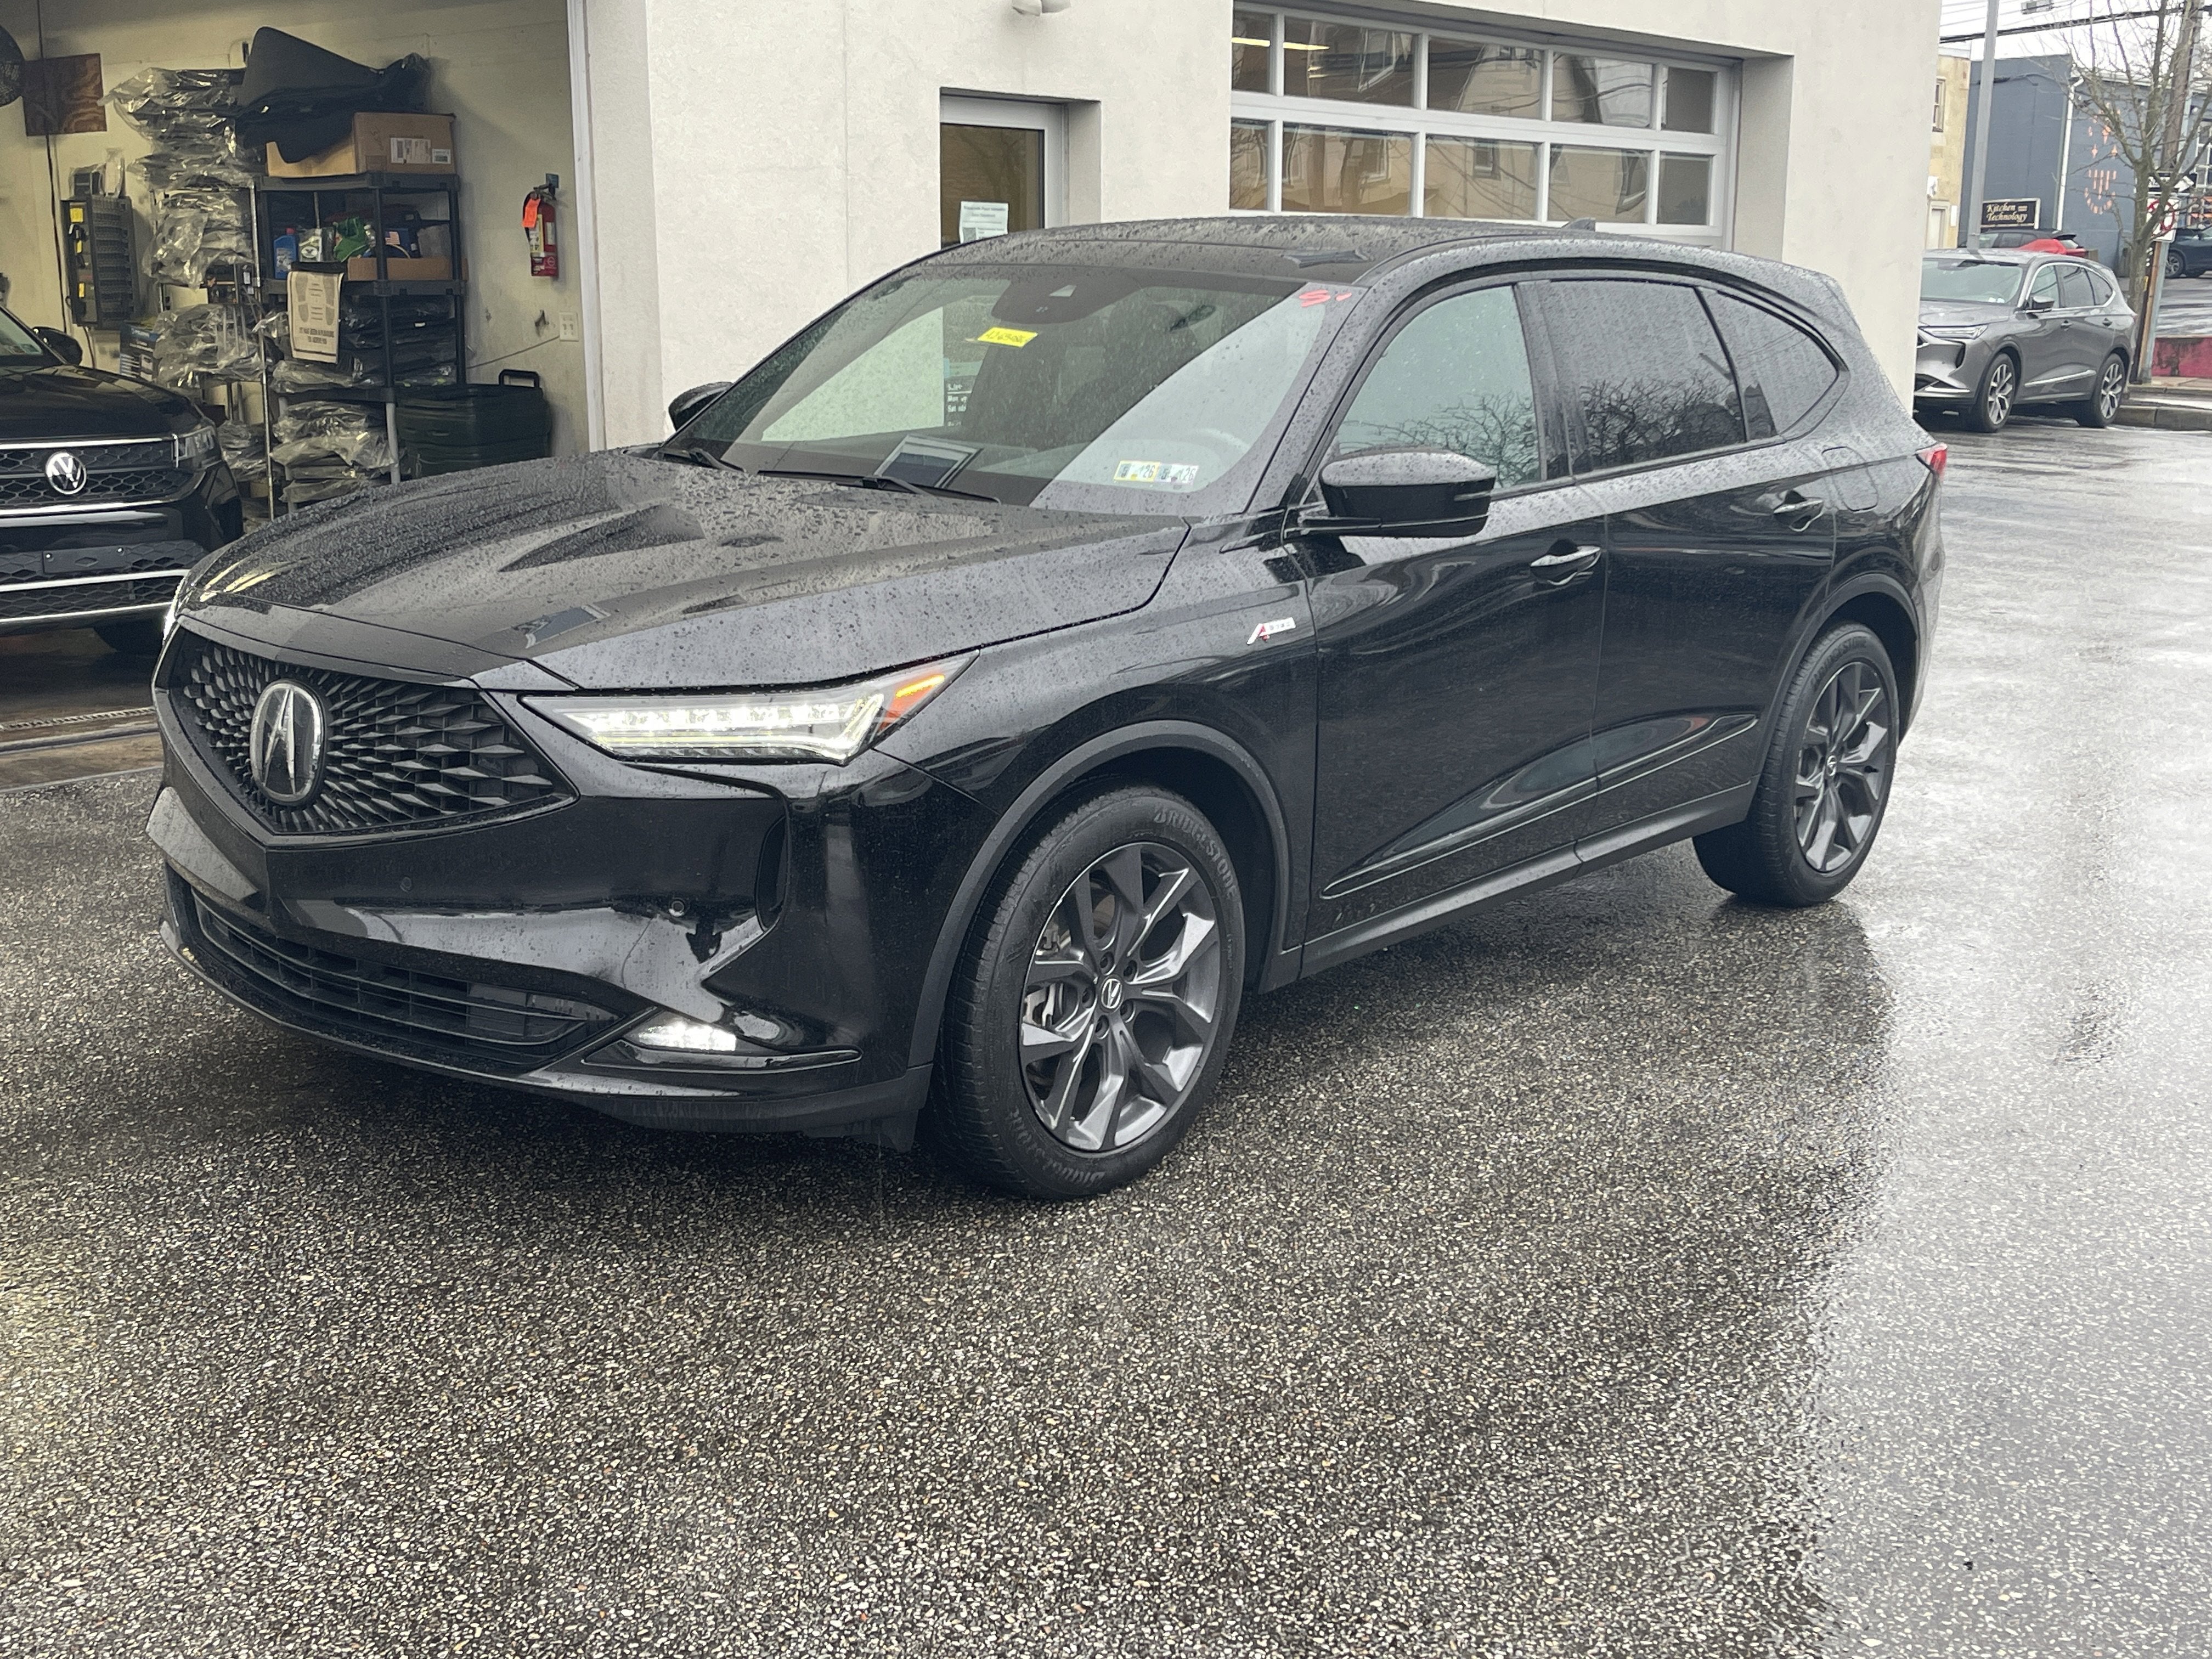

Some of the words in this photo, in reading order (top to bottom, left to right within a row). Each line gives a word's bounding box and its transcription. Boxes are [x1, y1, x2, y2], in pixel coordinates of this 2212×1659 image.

[1987, 202, 2016, 213] Kitchen
[1986, 211, 2028, 223] Technology
[1161, 468, 1169, 480] 5
[1153, 809, 1237, 901] BRIDGESTONE
